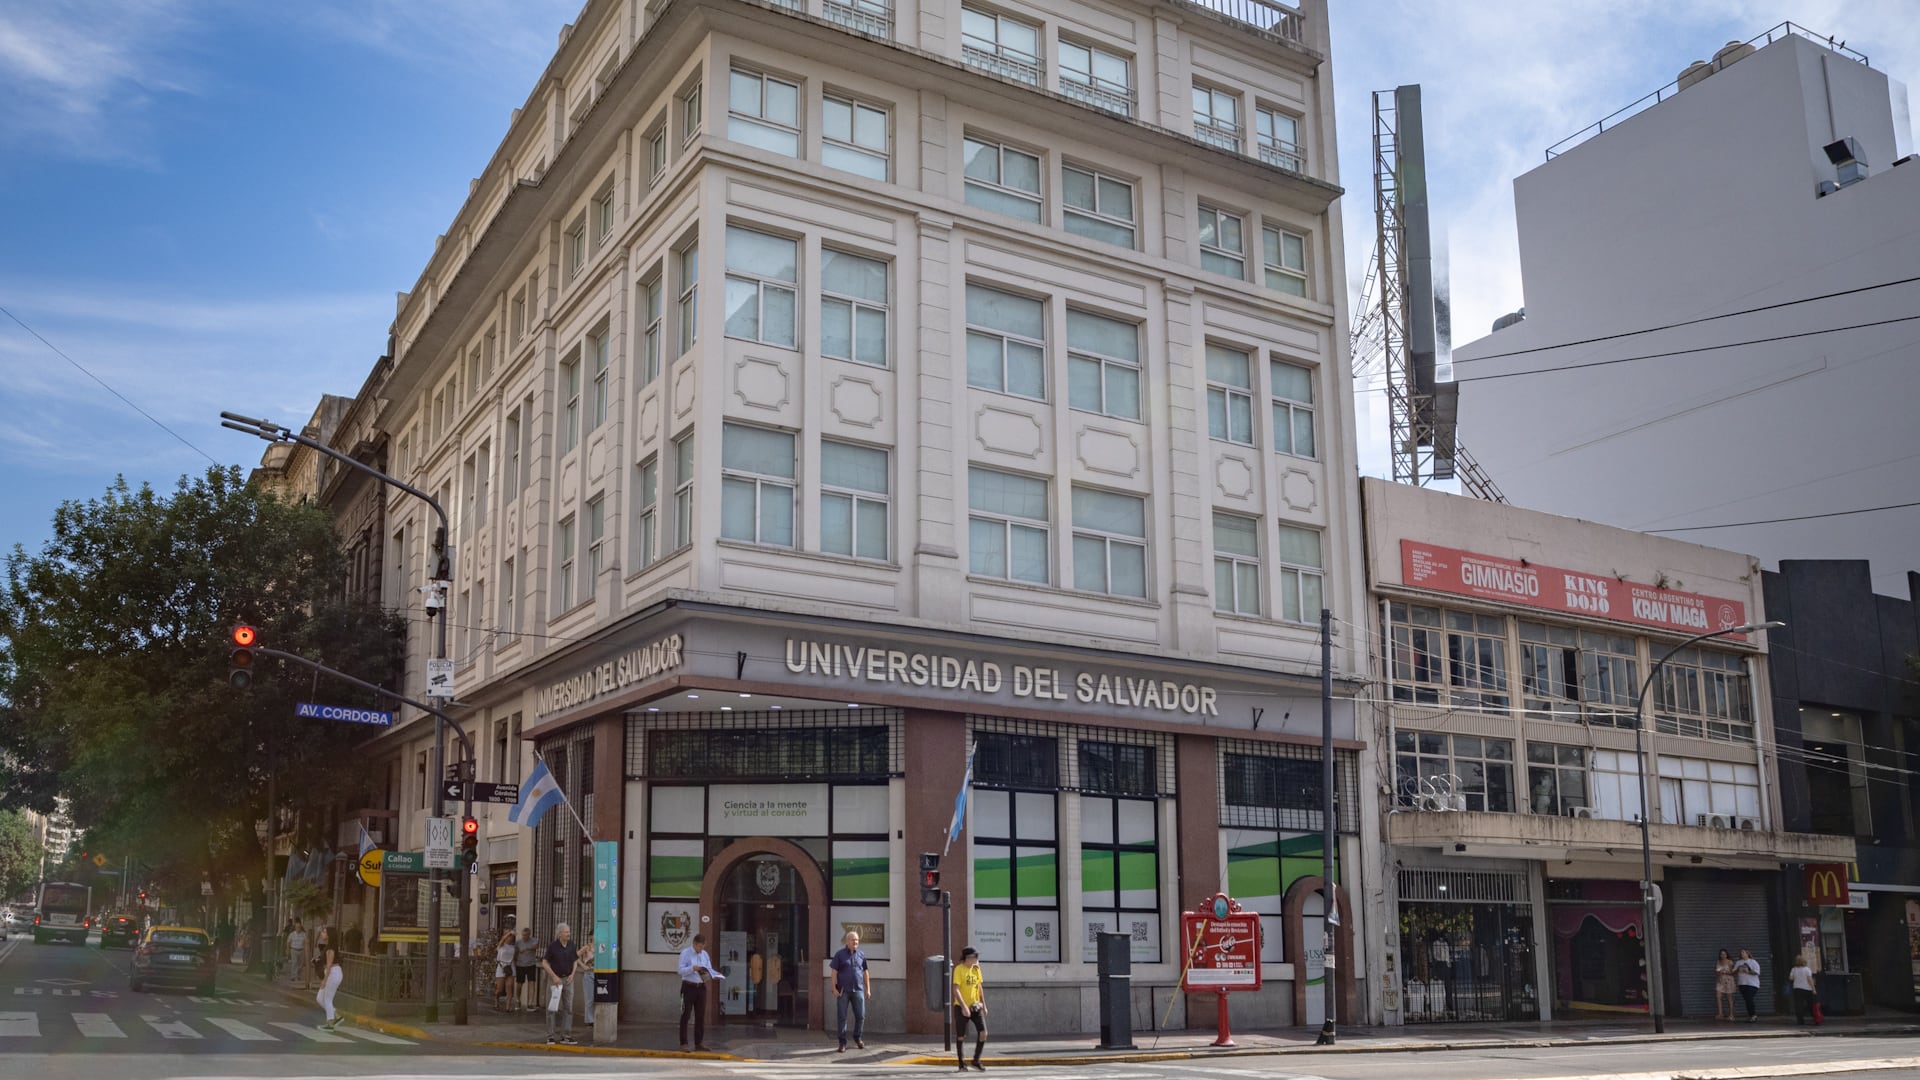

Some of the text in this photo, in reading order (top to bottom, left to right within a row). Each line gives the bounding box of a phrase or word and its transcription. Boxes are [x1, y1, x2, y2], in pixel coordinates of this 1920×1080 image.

[1461, 563, 1539, 597] GIMNASIO
[1564, 574, 1608, 597] KING
[1565, 591, 1610, 614] DOJO
[1631, 587, 1704, 608] CENTRO ARGENTINO DE
[1632, 597, 1668, 622] KRAV
[1670, 604, 1709, 629] MAGA
[535, 633, 681, 717] UNIVERSIDAD DEL SALVADOR
[785, 638, 1219, 716] UNIVERSIDAD DEL SALVADOR
[300, 704, 388, 725] AV. CORDOBA
[723, 809, 807, 819] y virtud al corazón
[724, 801, 757, 809] Ciencia
[767, 801, 775, 809] la
[777, 801, 807, 809] mente
[388, 855, 413, 863] Callao
[1309, 950, 1324, 960] USA
